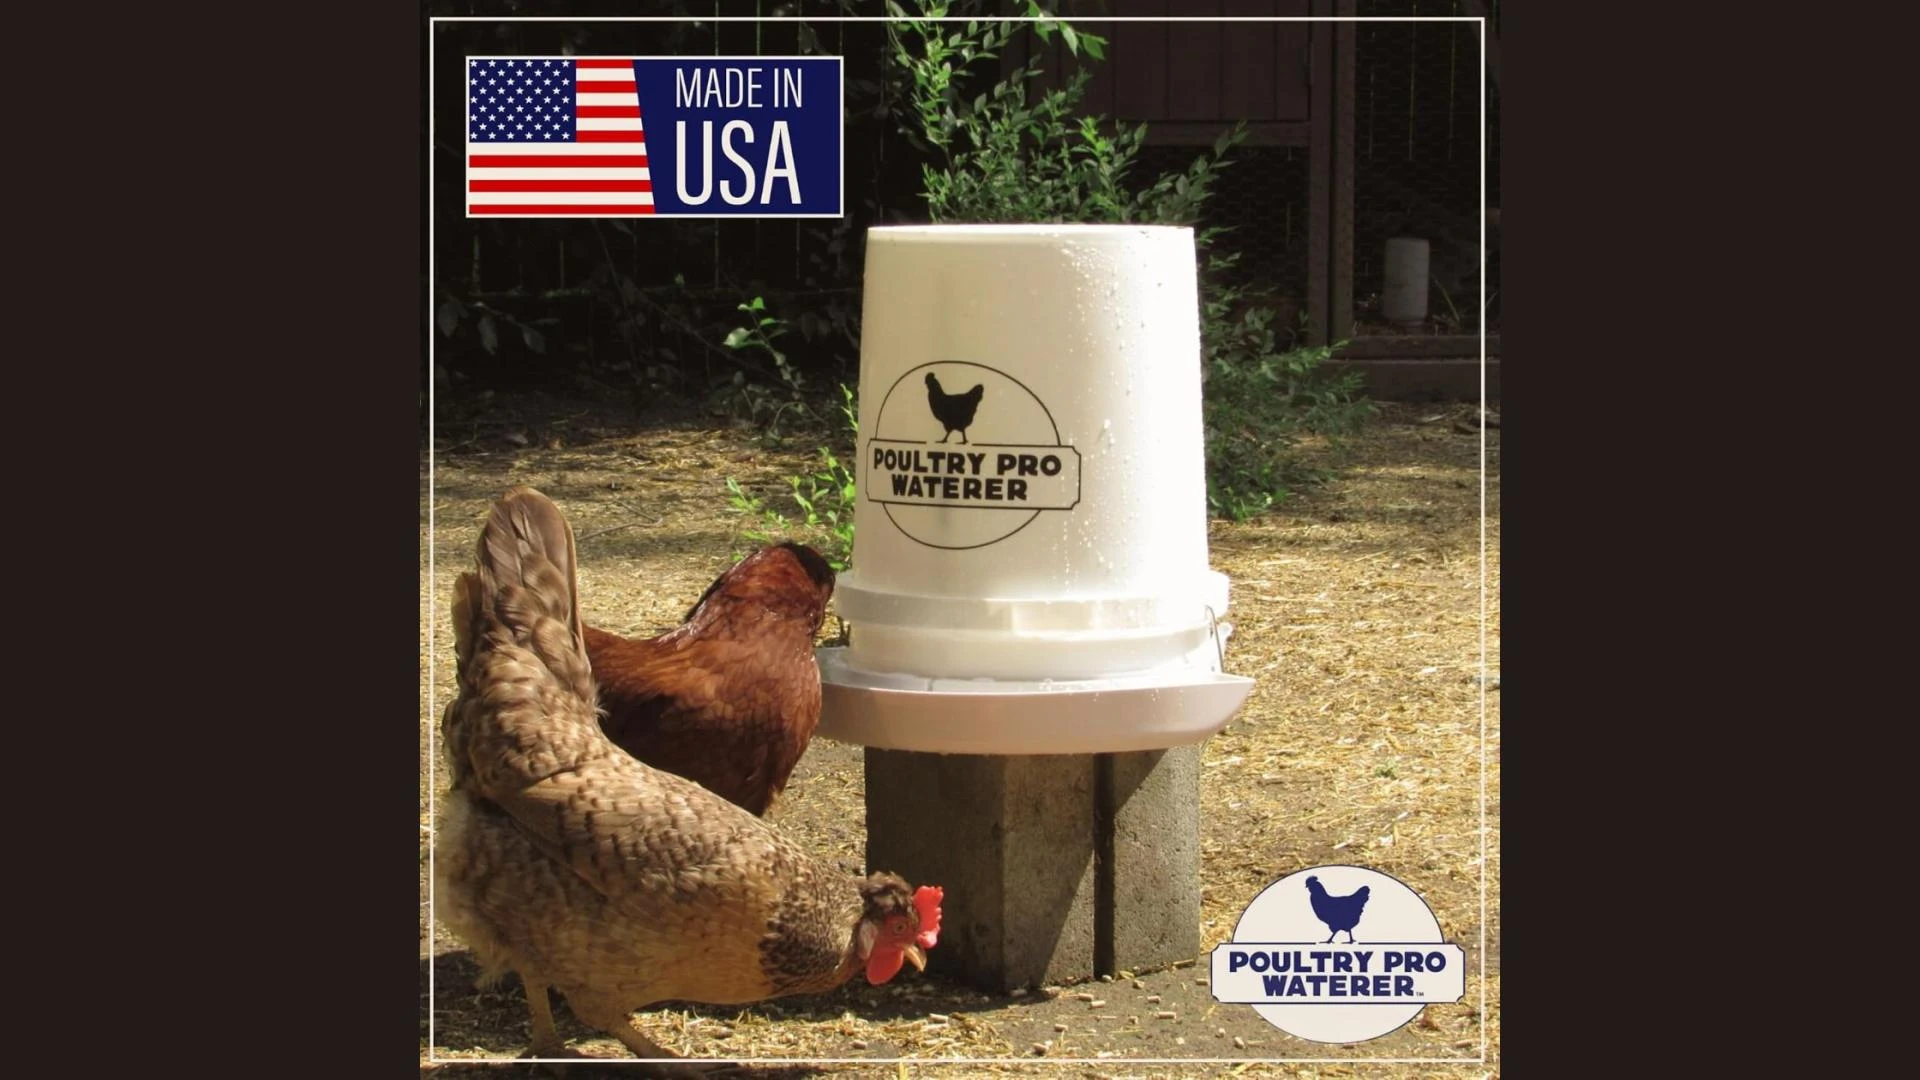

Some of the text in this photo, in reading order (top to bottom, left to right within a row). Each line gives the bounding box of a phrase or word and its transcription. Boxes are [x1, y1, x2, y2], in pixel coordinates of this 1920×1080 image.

[873, 447, 1062, 477] POULTRY PRO
[891, 474, 1028, 501] WATERER
